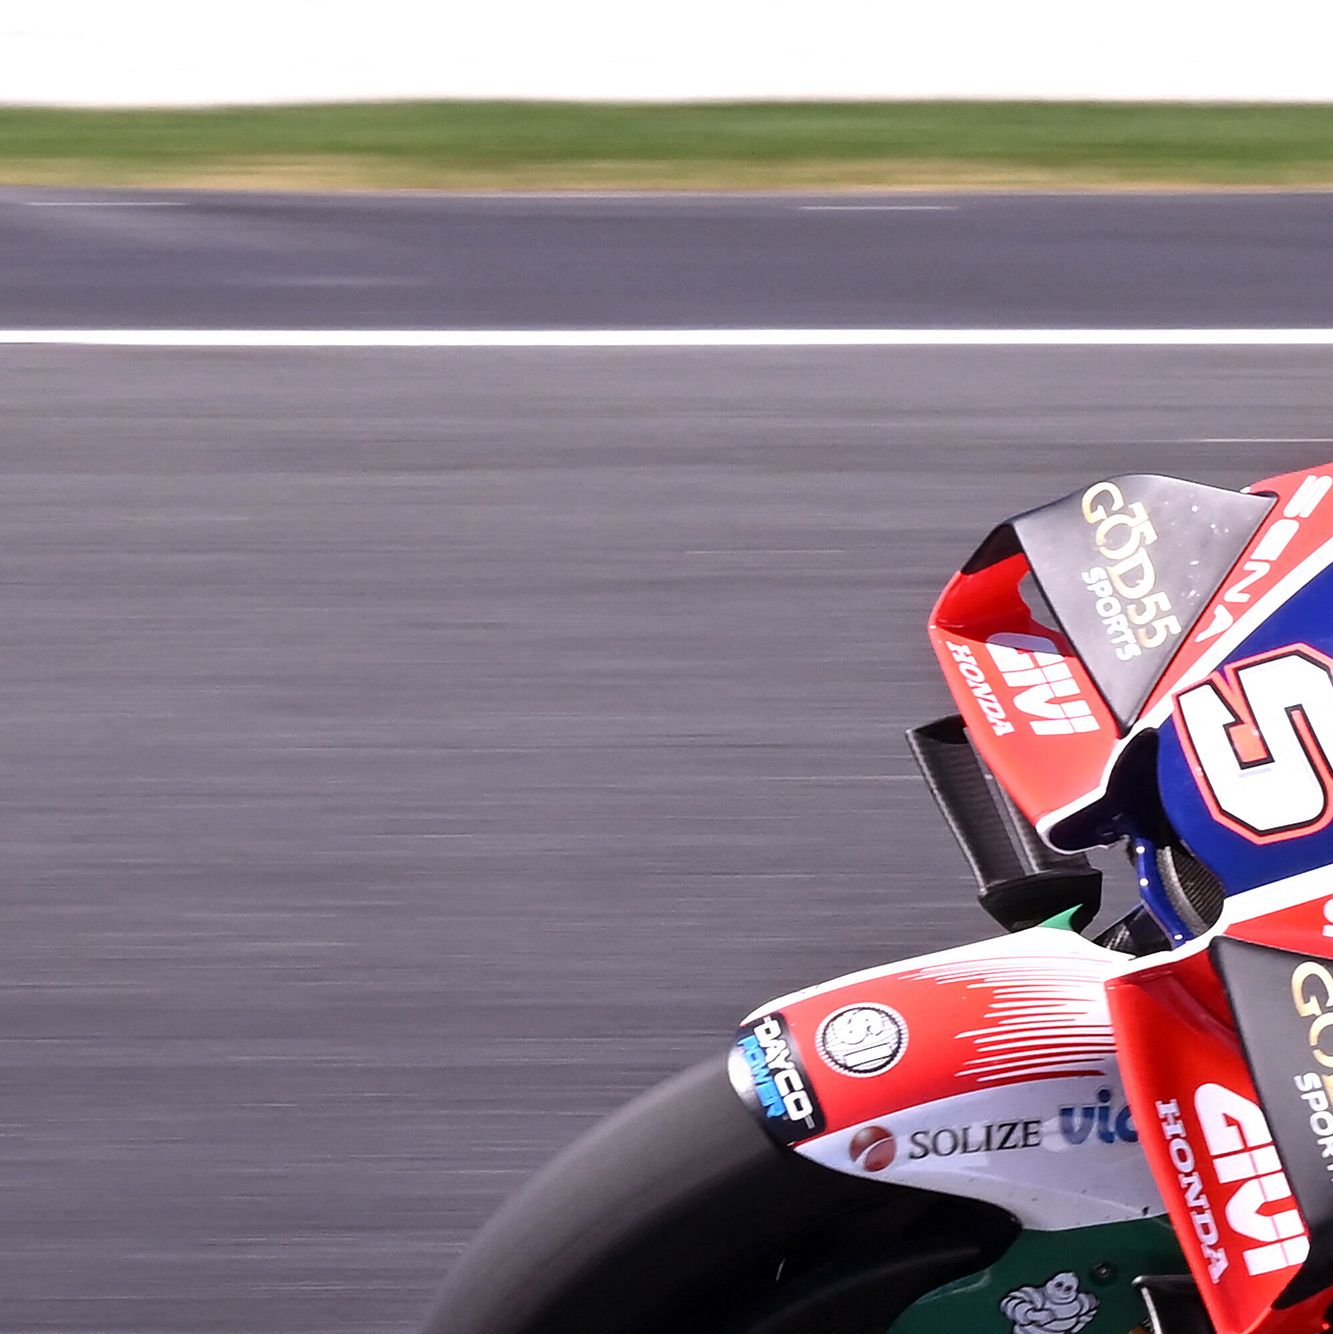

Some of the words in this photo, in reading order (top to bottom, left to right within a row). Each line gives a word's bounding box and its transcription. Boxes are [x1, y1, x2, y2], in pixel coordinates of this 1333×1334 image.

[1080, 566, 1143, 662] SPORTS
[945, 641, 1016, 737] HONDA
[737, 1034, 786, 1119] POWER
[752, 1019, 814, 1122] DAYCO
[909, 1118, 1043, 1161] SOLIZE
[1194, 1083, 1311, 1276] GIVI
[1155, 1098, 1230, 1285] HONDA
